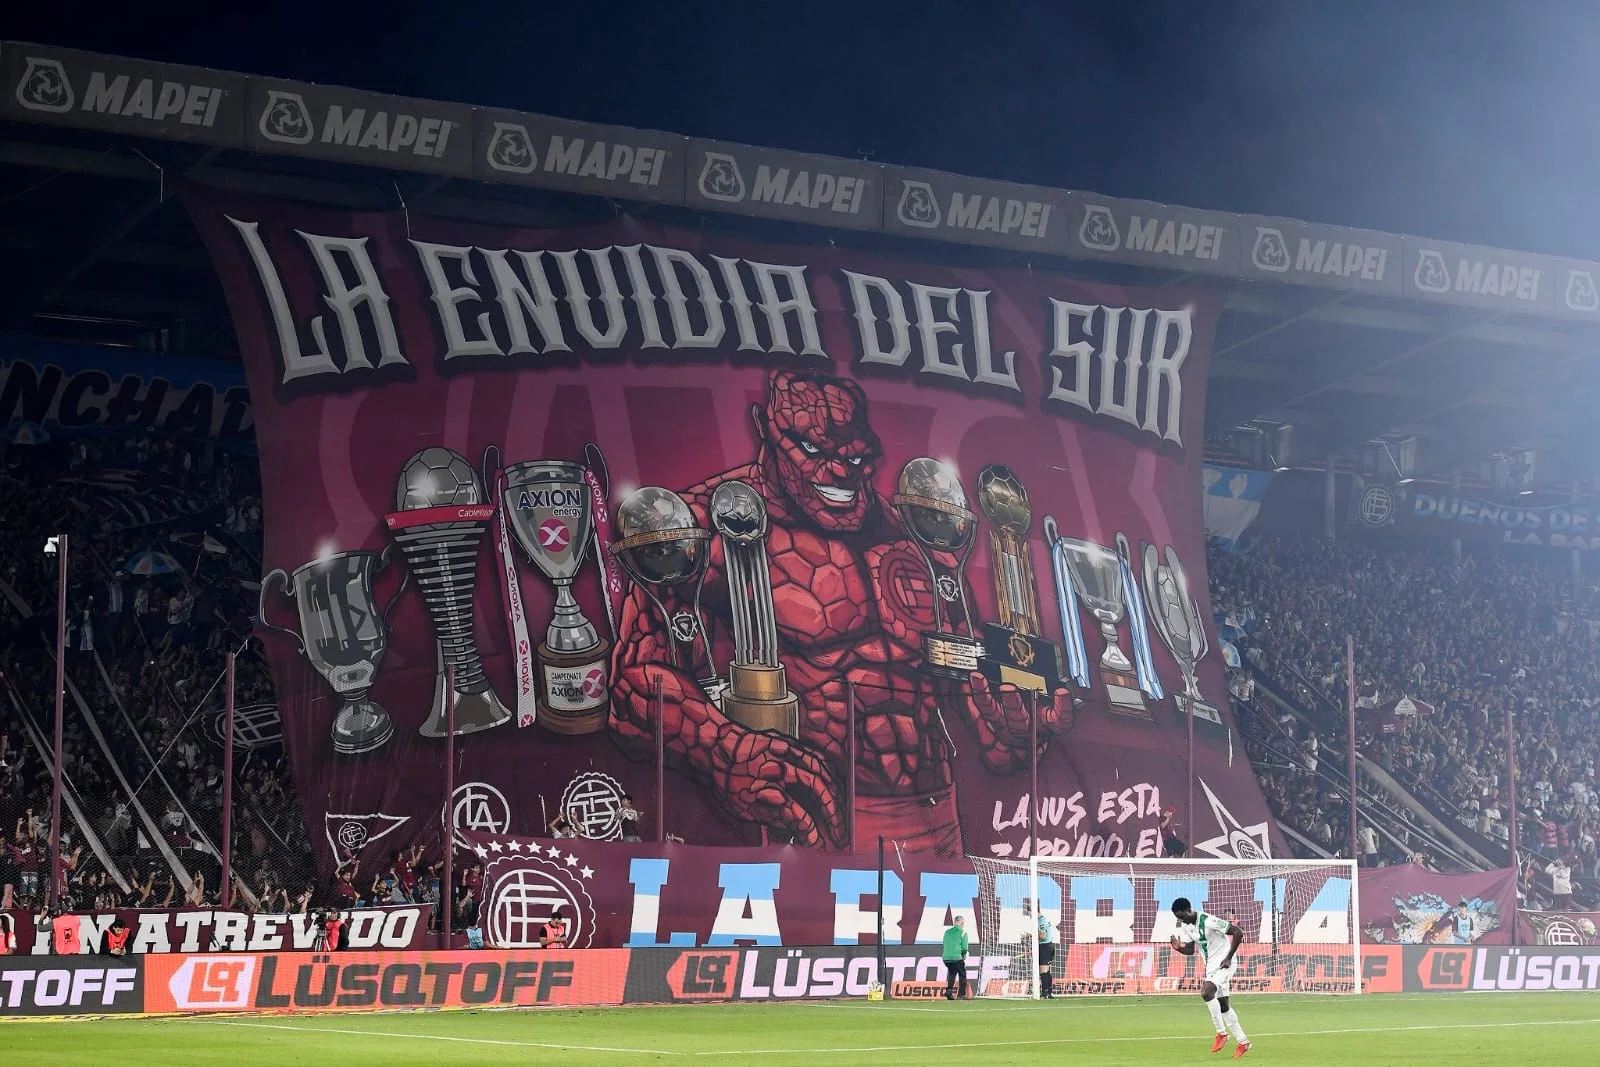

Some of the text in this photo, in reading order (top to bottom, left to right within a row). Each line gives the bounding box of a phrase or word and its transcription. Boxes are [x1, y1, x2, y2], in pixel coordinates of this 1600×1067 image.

[81, 72, 222, 127] MAPEI
[321, 105, 454, 157] MAPEI
[543, 135, 665, 186] MAPEI
[752, 165, 865, 214] MAPEI
[946, 191, 1052, 238] MAPEI
[1126, 215, 1223, 260] MAPEI
[1296, 238, 1388, 281] MAPEI
[1455, 260, 1541, 301] MAPEI
[224, 214, 410, 384] LA
[840, 268, 1021, 392] DEL
[1048, 296, 1193, 448] SUR
[517, 489, 582, 510] AXION
[587, 470, 604, 505] AXION
[553, 508, 583, 518] energy
[1550, 508, 1592, 532] DE
[1504, 530, 1544, 546] LA
[551, 687, 584, 697] AXION
[1097, 783, 1161, 824] ESTA
[623, 858, 783, 947] LA
[1253, 876, 1353, 944] 14
[132, 908, 420, 953] ATREVDO
[0, 970, 137, 1007] TOFF
